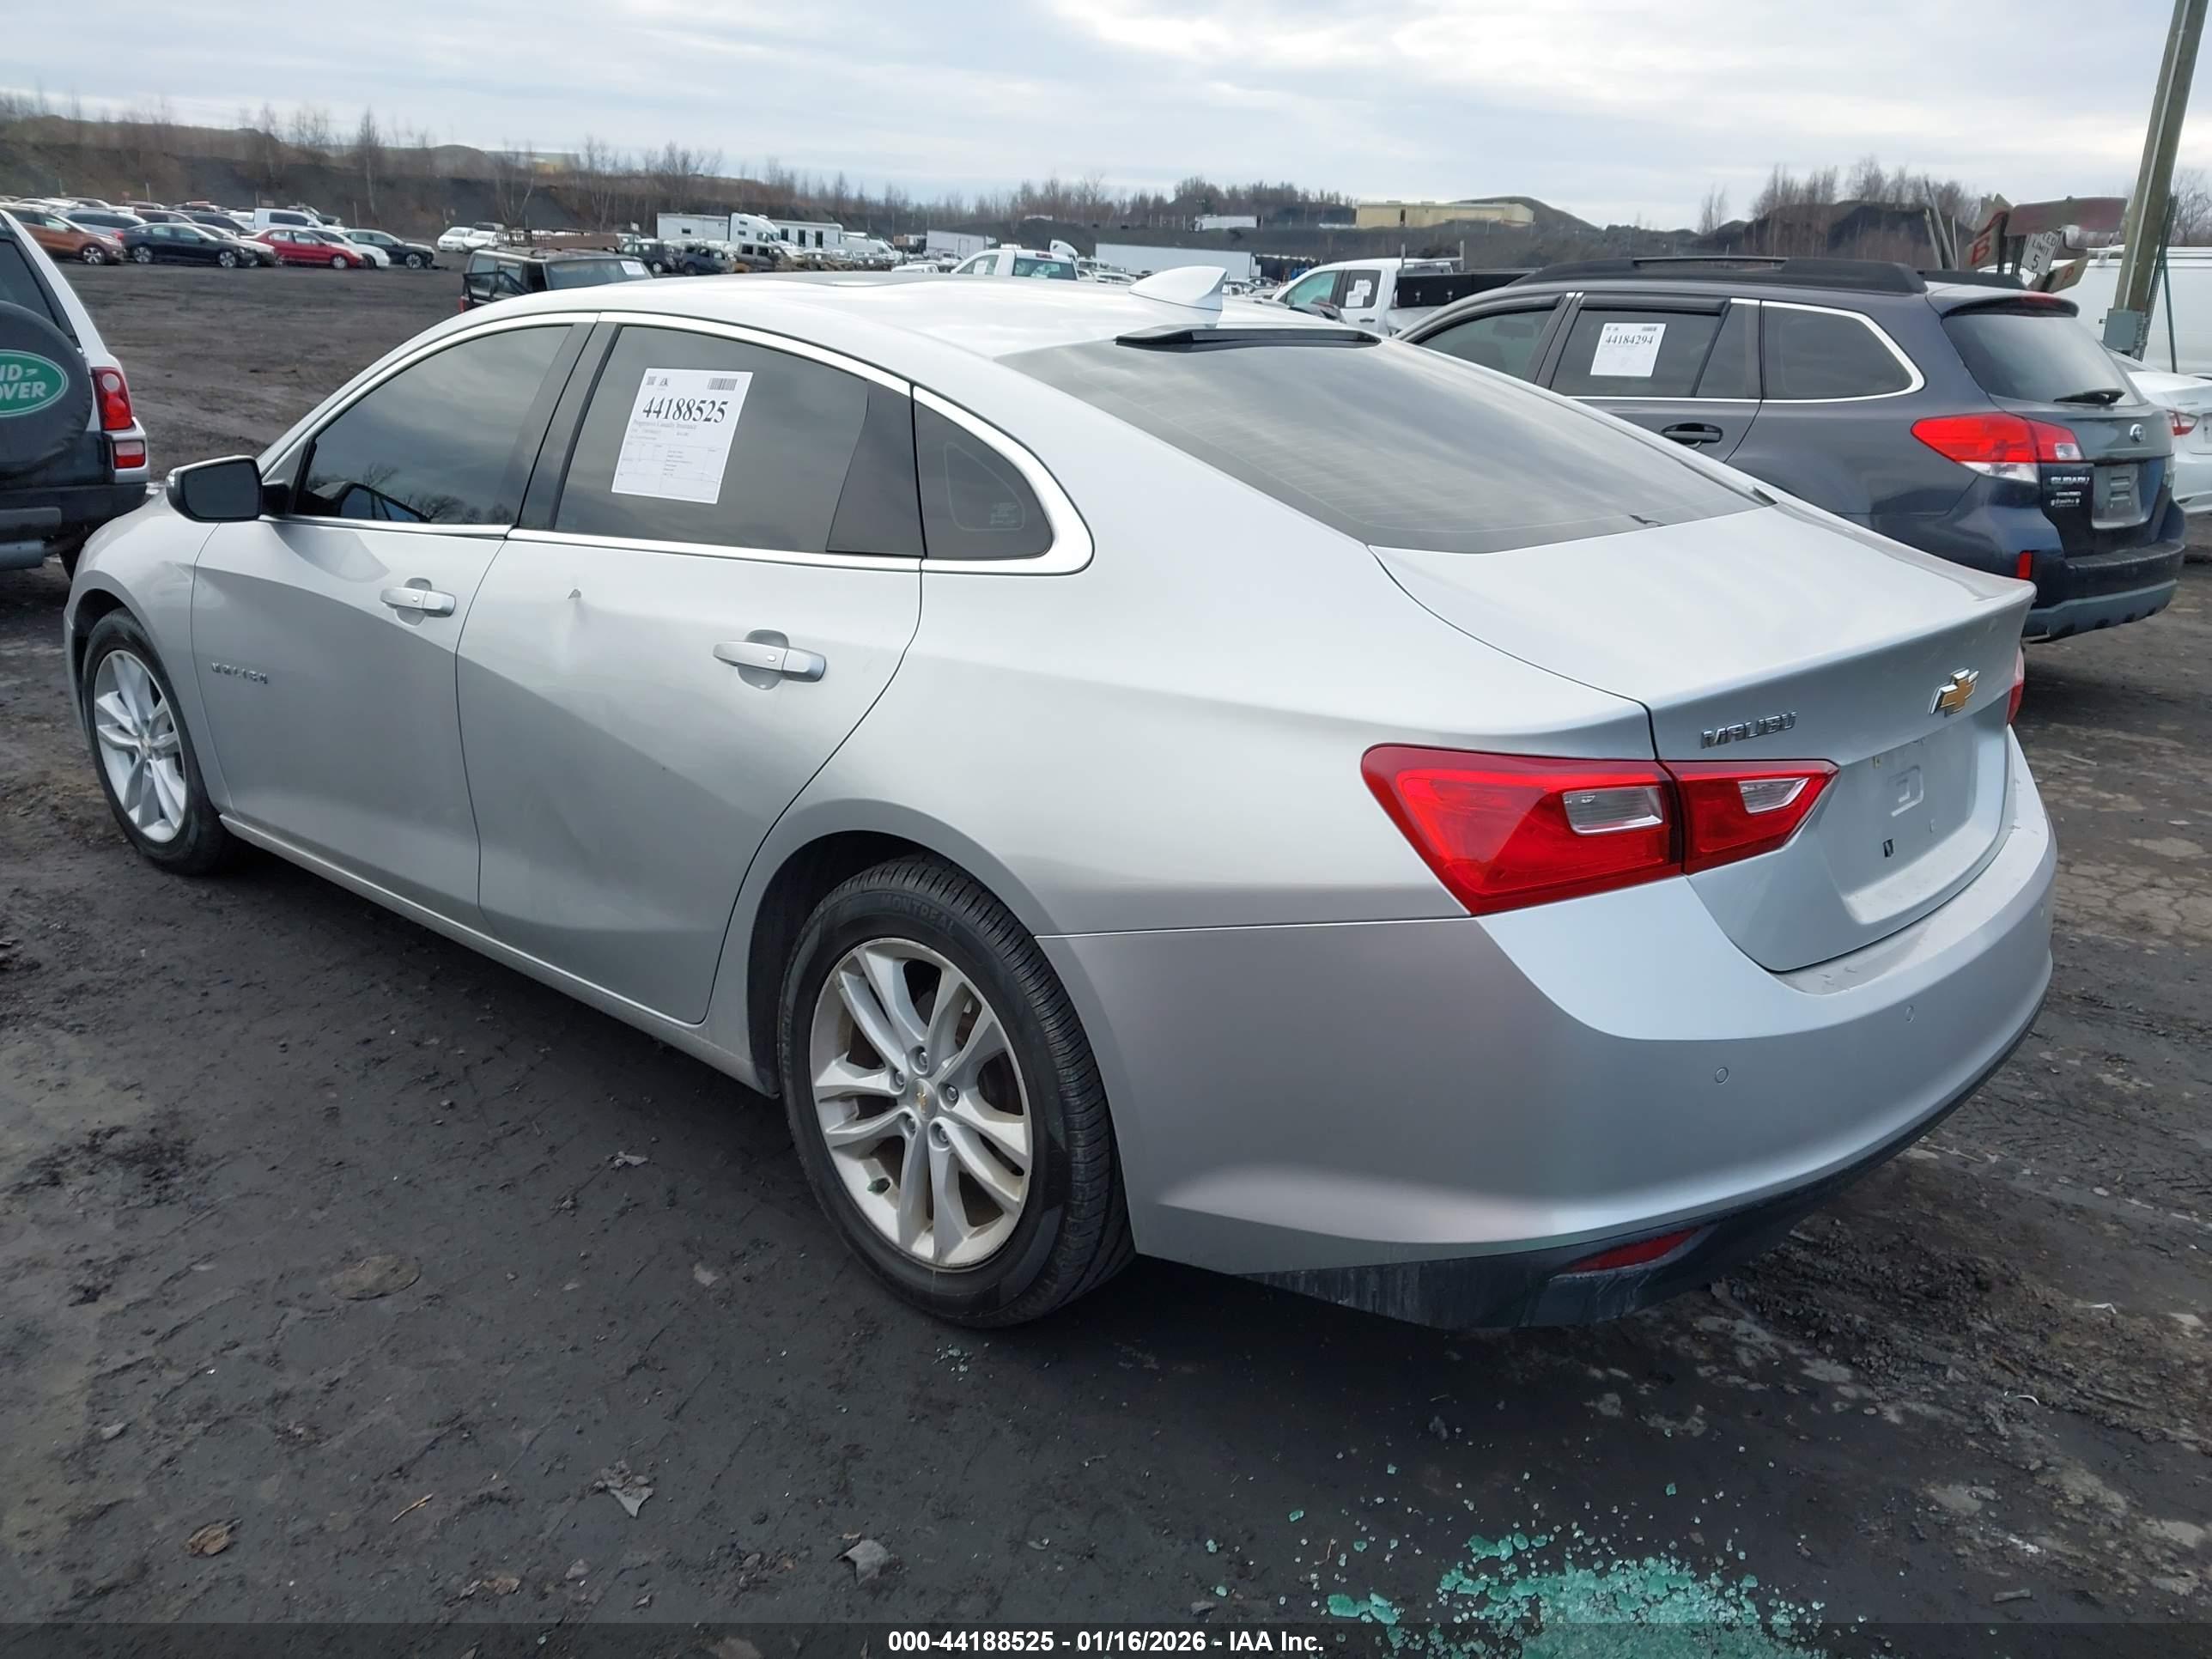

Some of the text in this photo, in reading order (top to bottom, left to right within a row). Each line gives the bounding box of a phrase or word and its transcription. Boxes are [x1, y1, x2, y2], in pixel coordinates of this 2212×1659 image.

[2032, 239, 2050, 257] LIMIT
[2032, 253, 2041, 270] 5
[1605, 334, 1654, 344] 44184294
[0, 381, 47, 400] VER
[642, 397, 728, 423] 44188525
[1701, 712, 1797, 749] MALIBU
